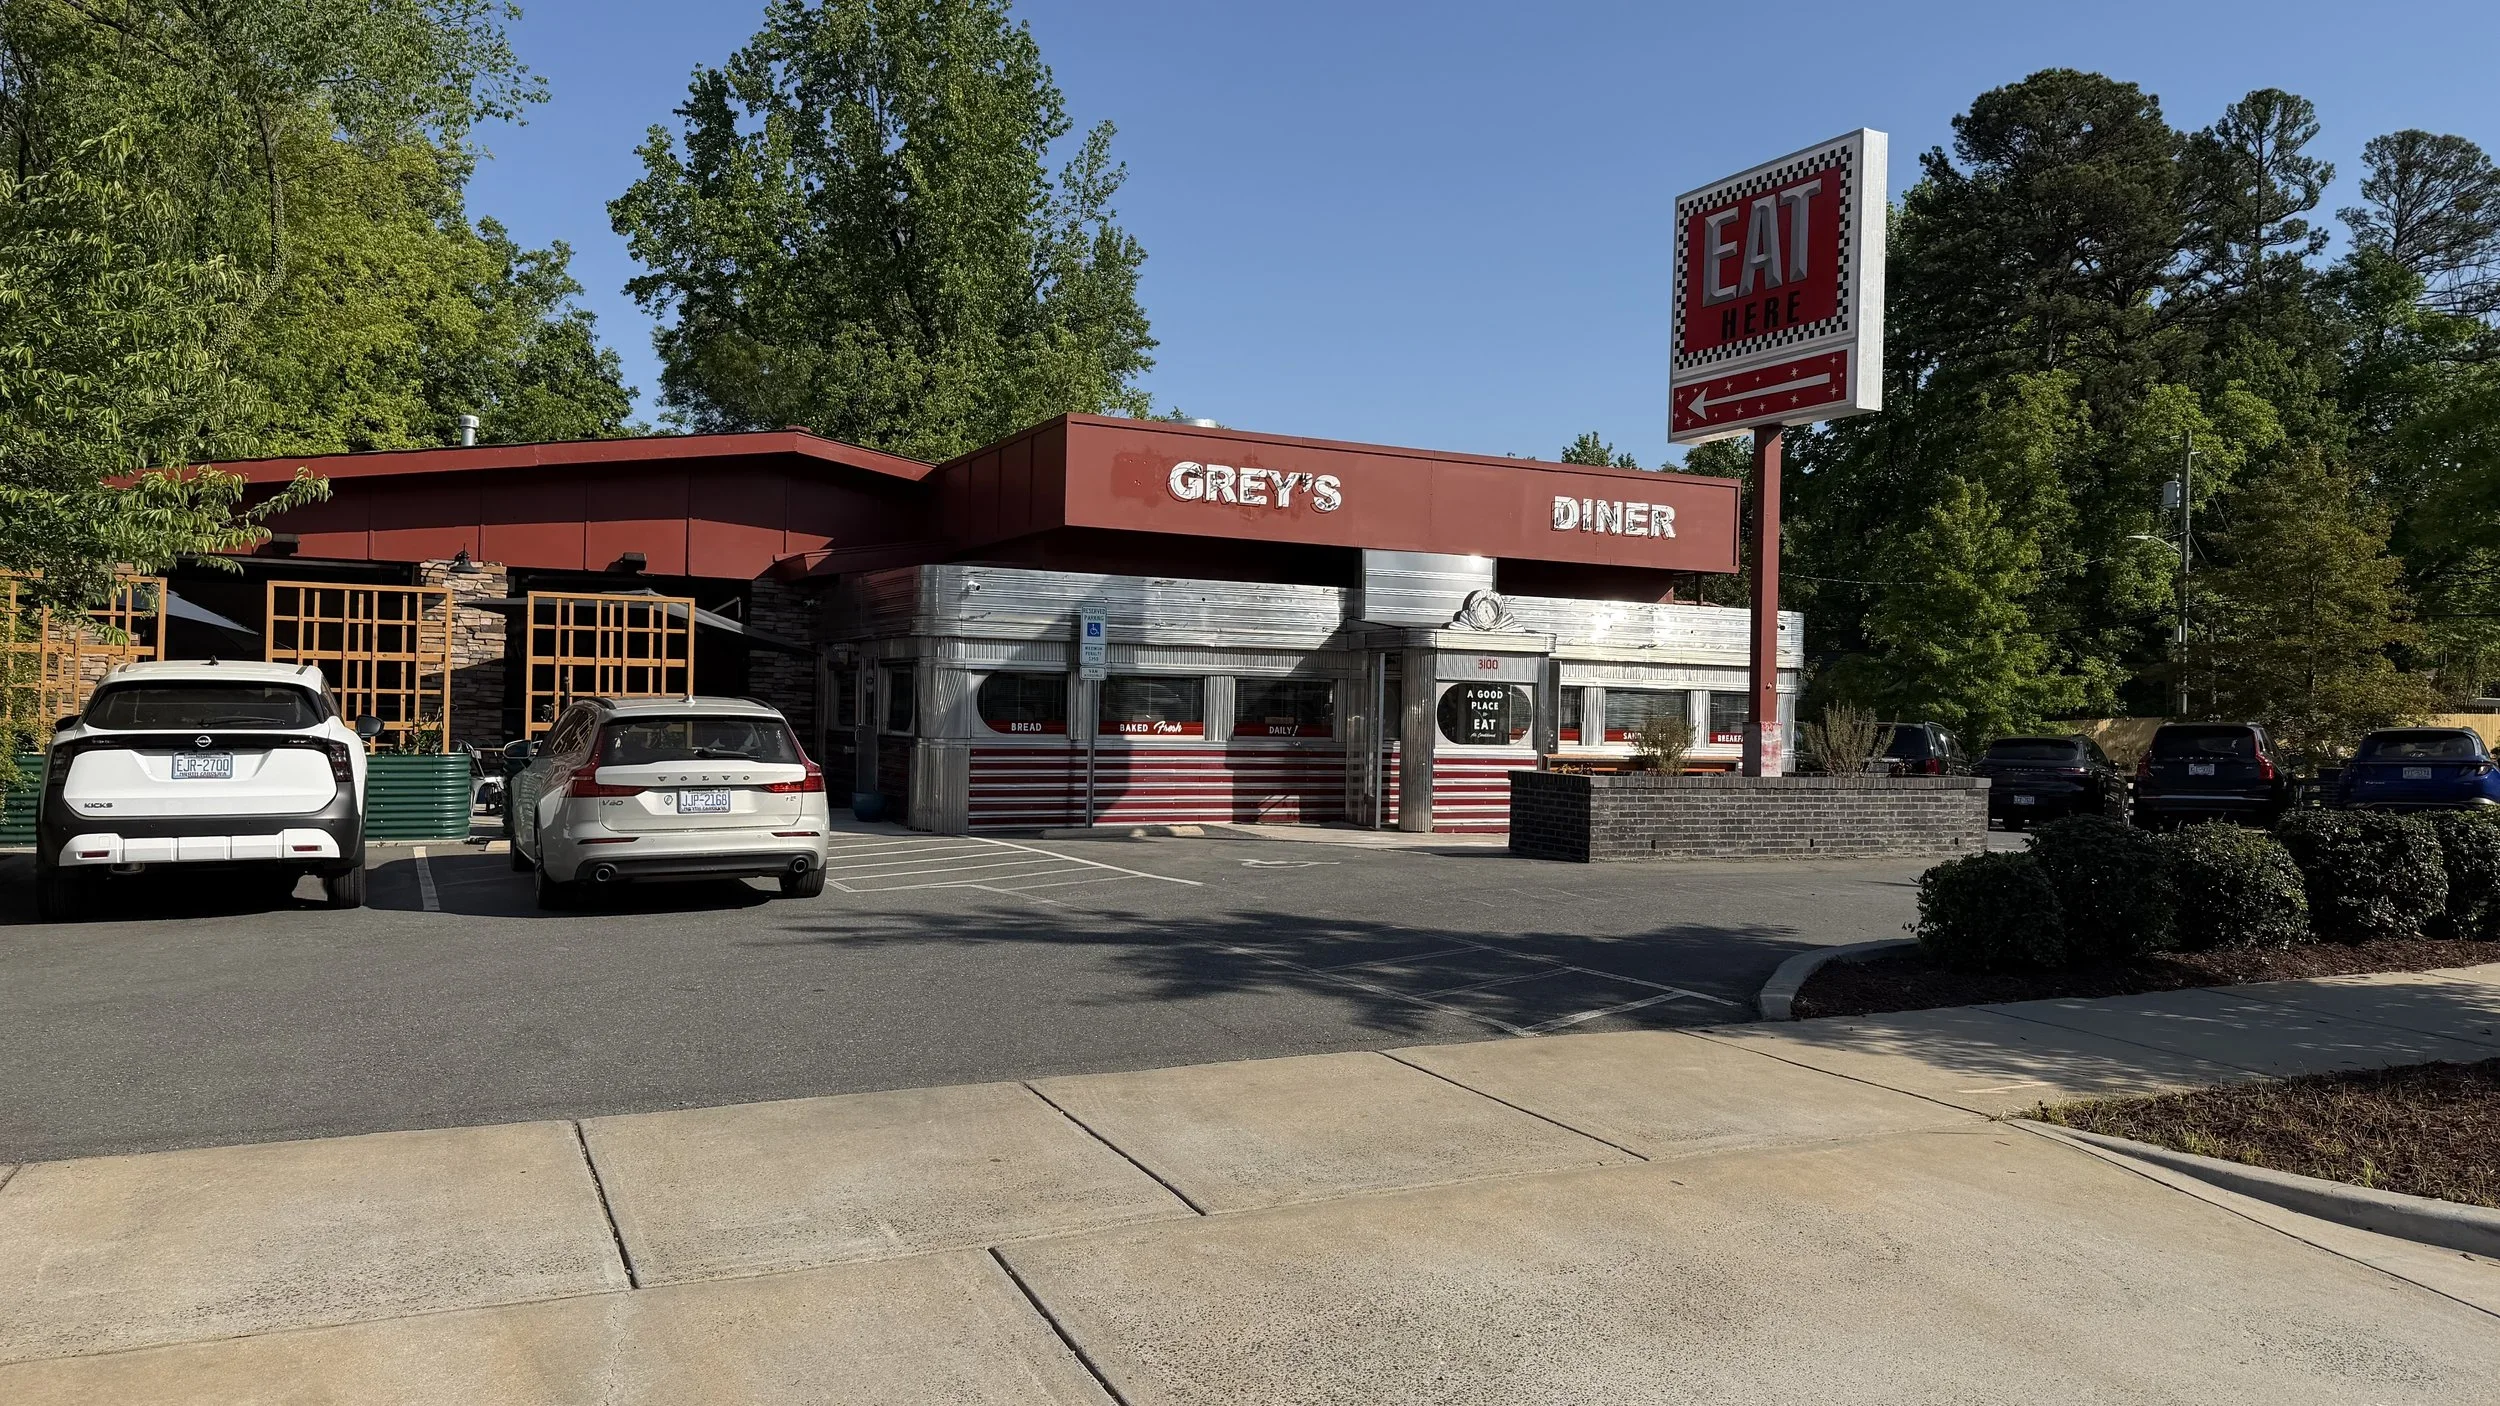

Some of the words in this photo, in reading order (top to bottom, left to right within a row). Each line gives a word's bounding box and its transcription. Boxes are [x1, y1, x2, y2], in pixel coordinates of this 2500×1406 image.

[1702, 178, 1822, 308] EAT
[1721, 290, 1800, 340] HERE
[1167, 461, 1342, 513] GREY'S
[1552, 496, 1677, 539] DINER
[1478, 659, 1498, 669] 3100
[1467, 689, 1474, 698] A
[1477, 690, 1503, 699] GOOD
[1471, 701, 1499, 710] PLACE
[1011, 722, 1042, 731] BREAD
[1119, 723, 1149, 732] BAKED
[1153, 720, 1183, 734] Fresh
[1269, 725, 1298, 737] DAILY!
[1474, 719, 1496, 730] EAT
[177, 759, 229, 772] EJR-2700
[682, 793, 728, 807] JJP-2168
